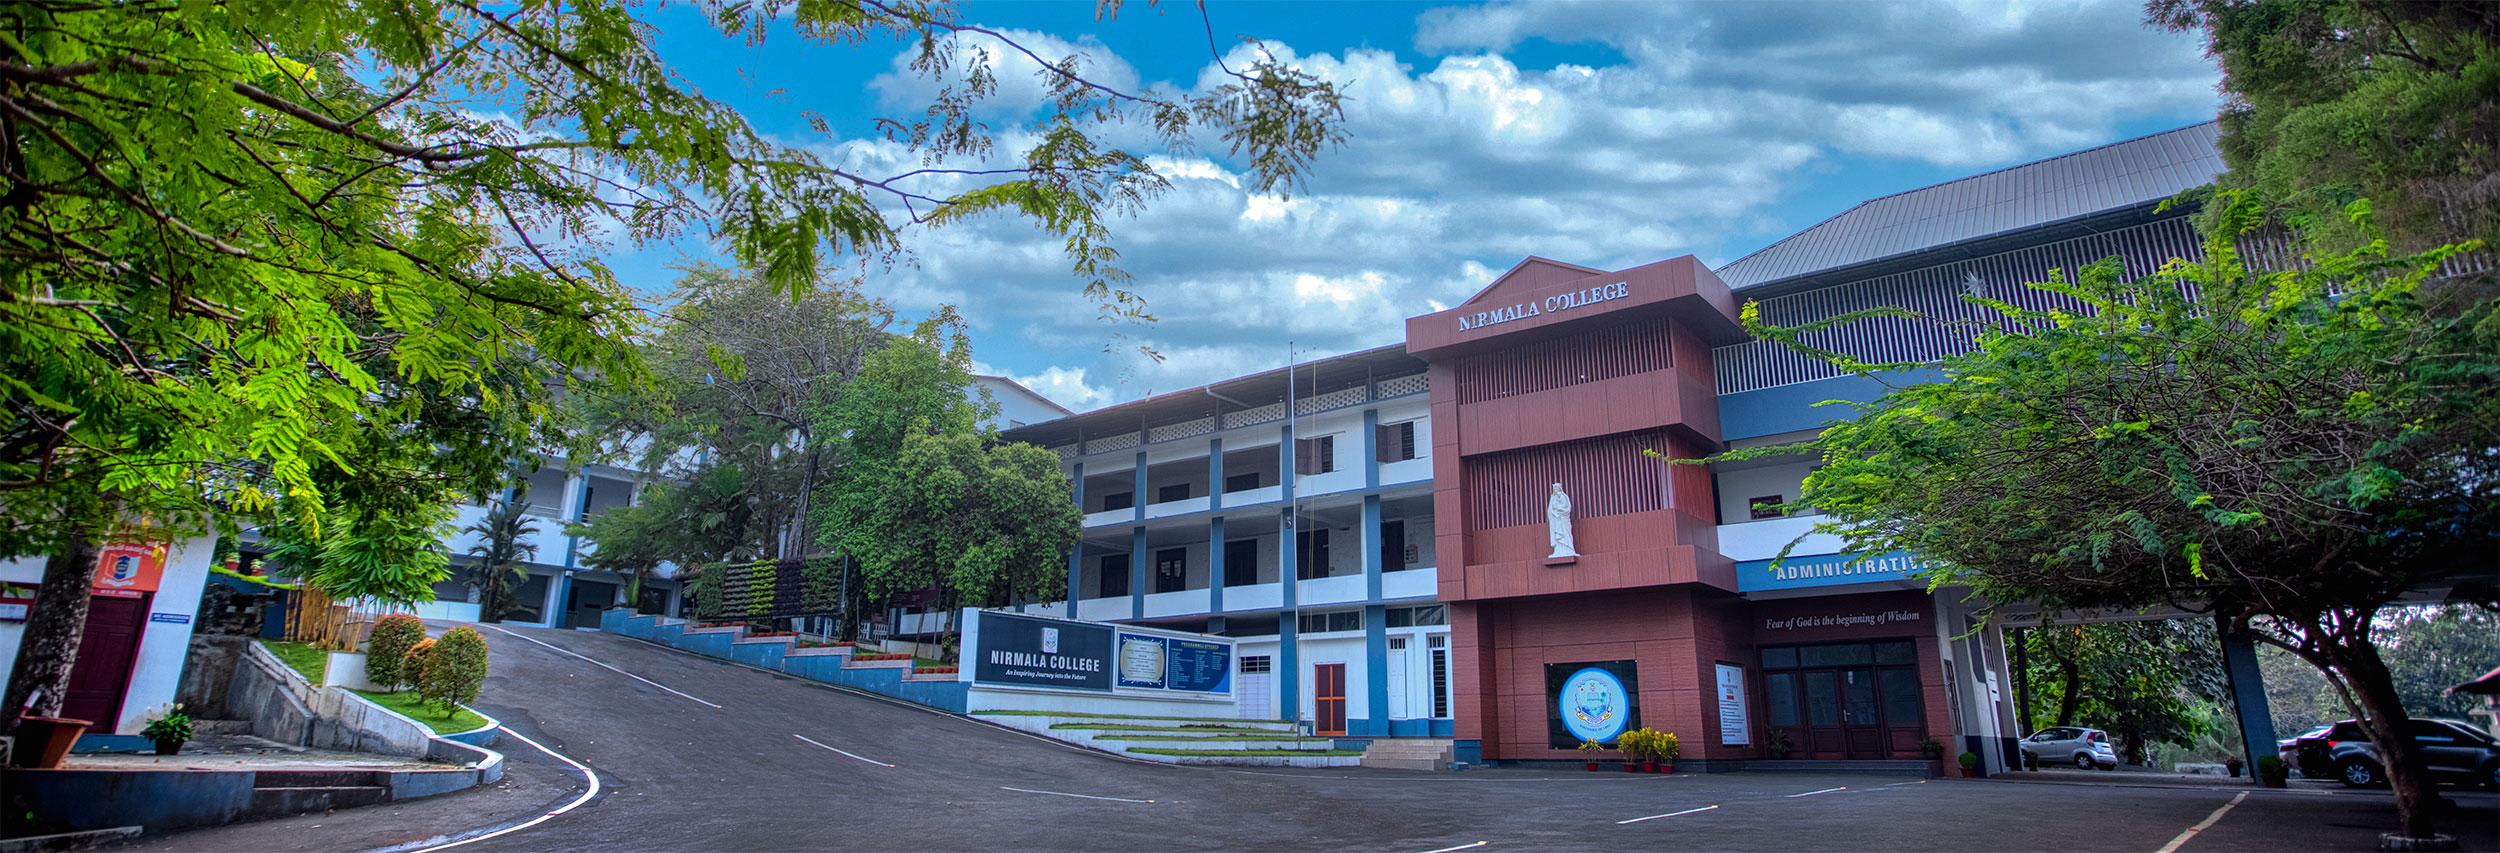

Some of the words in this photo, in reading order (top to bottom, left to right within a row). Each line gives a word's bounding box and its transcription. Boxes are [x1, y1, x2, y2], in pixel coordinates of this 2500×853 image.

[1458, 301, 1541, 332] NIRMALA
[1545, 281, 1629, 313] COLLEGE
[1766, 618, 1785, 629] Fear
[1785, 617, 1795, 630] of
[1796, 616, 1813, 627] God
[1813, 615, 1821, 626] is
[1822, 615, 1835, 626] the
[1835, 613, 1876, 627] beginning
[1877, 611, 1887, 625] of
[1887, 610, 1920, 622] Wisdom
[990, 650, 1047, 668] NIRMALA
[1050, 655, 1100, 672] COLLEGE
[1013, 669, 1035, 678] Inspiring
[1035, 671, 1054, 679] Journey
